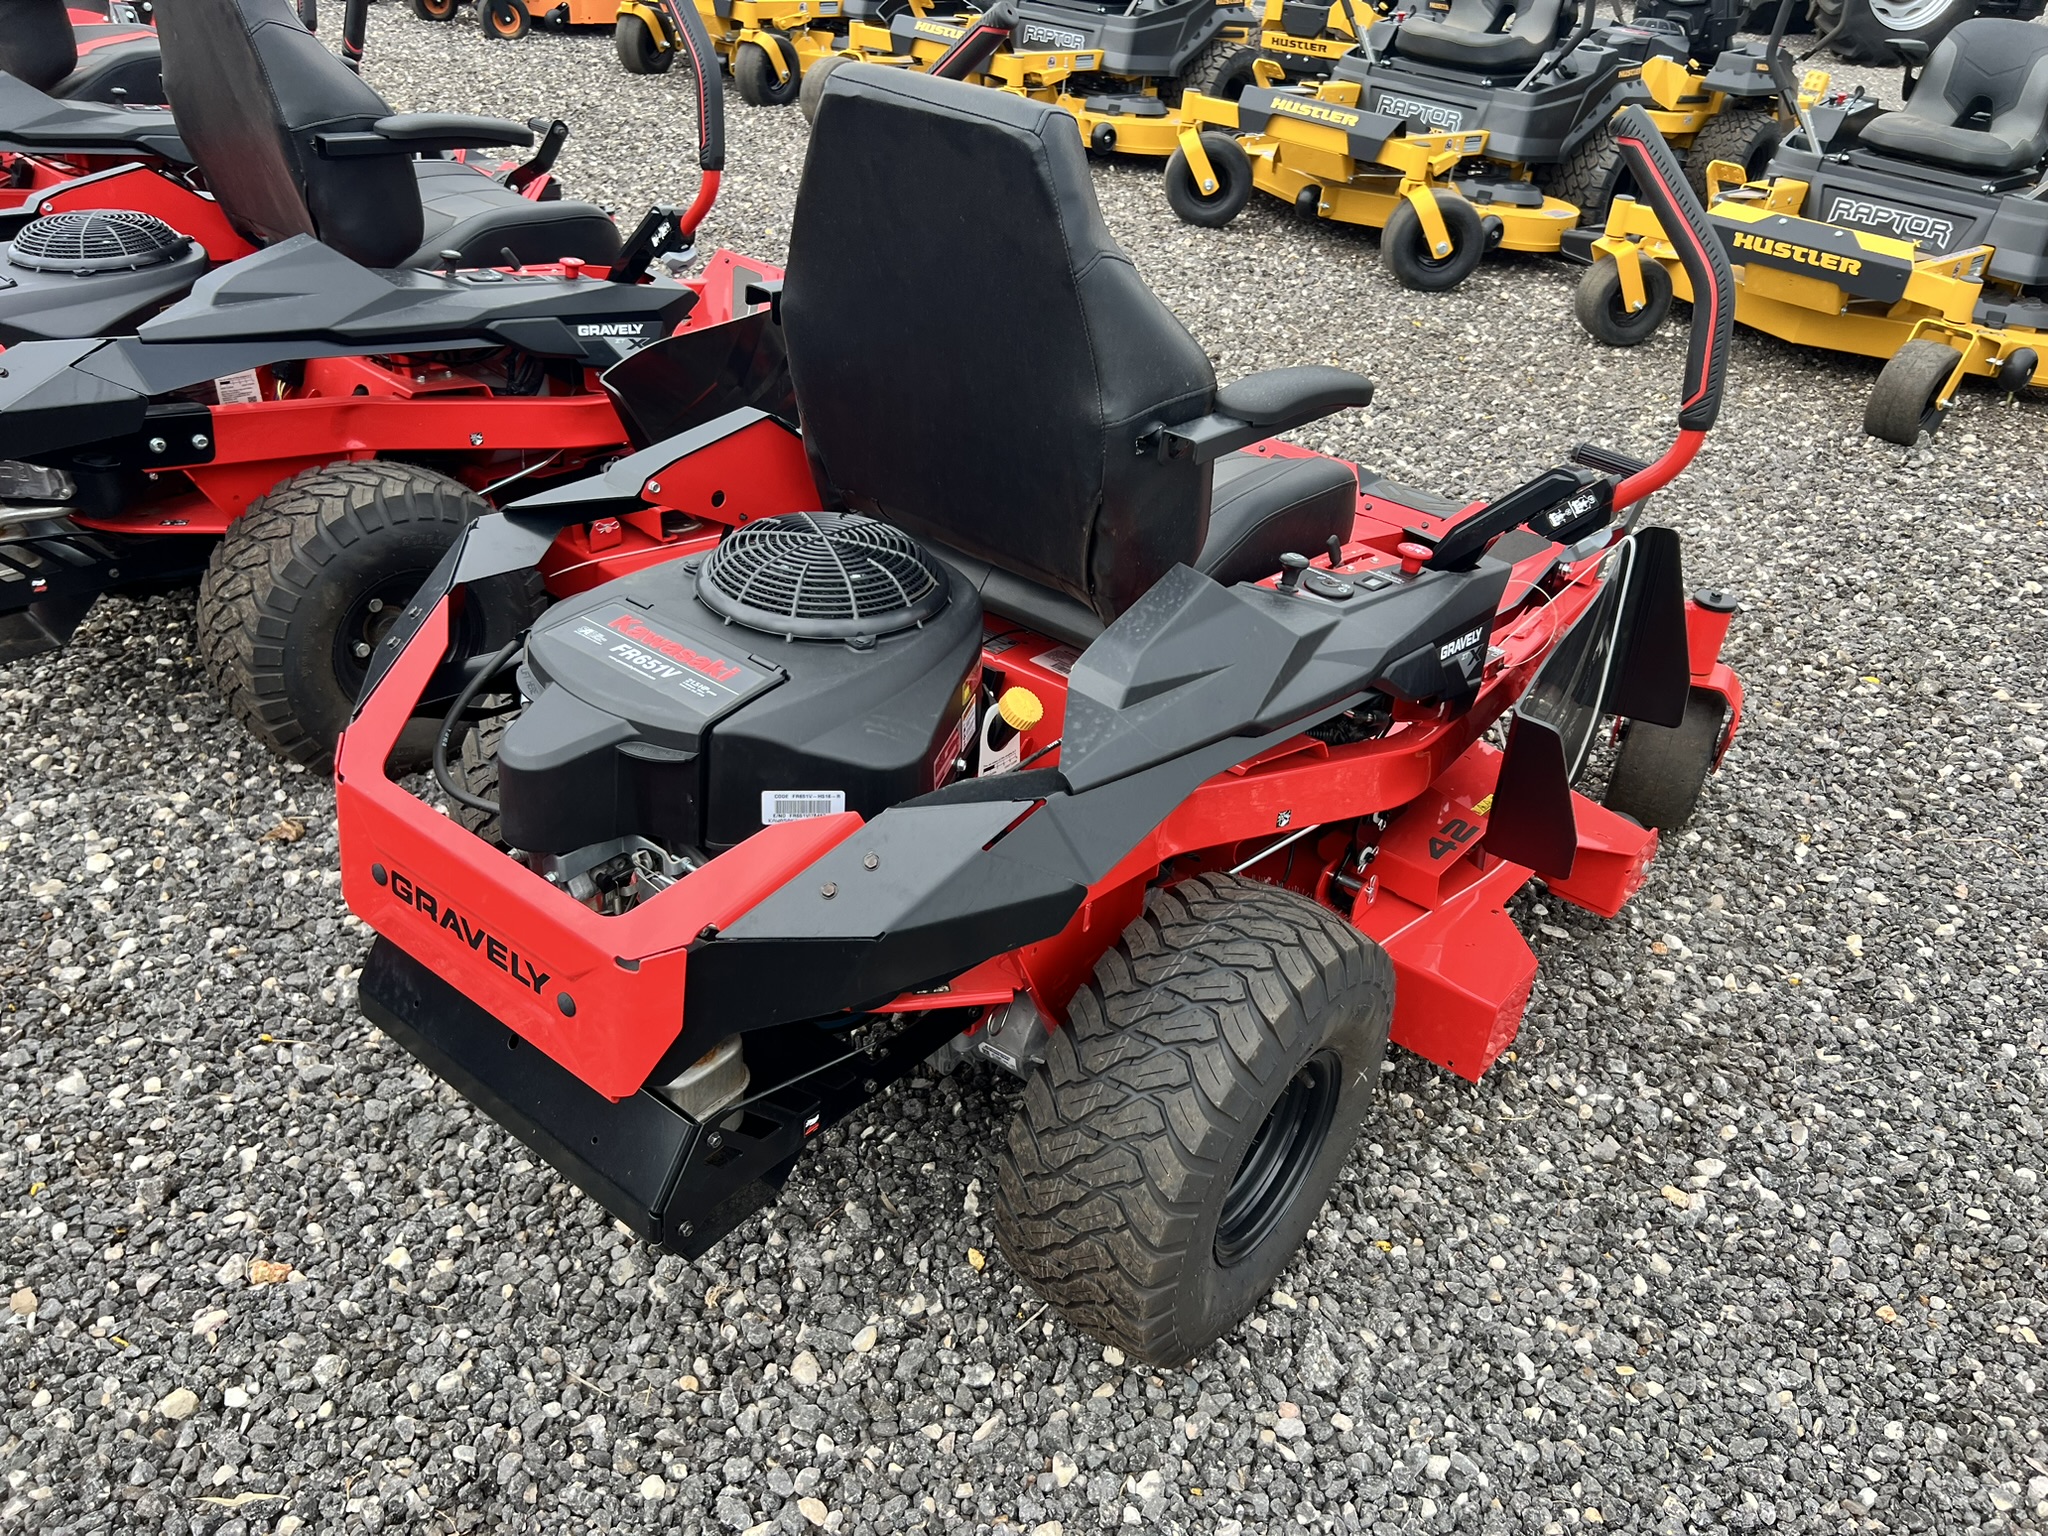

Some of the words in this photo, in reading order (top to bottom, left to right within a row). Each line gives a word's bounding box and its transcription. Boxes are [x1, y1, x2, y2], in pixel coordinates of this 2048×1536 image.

[1023, 24, 1085, 49] RAPTOR
[1271, 37, 1327, 53] HUSTLER
[1270, 97, 1359, 127] HUSTLER
[1376, 94, 1462, 132] RAPTOR
[1827, 197, 1953, 249] RAPTOR
[1732, 231, 1863, 276] HUSTLER
[577, 323, 644, 336] GRAVELY
[607, 614, 741, 682] Kawasaki
[609, 643, 682, 678] FR651V
[1440, 627, 1483, 660] GRAVELY
[1428, 818, 1480, 860] 42
[391, 870, 551, 995] GRAVELY
